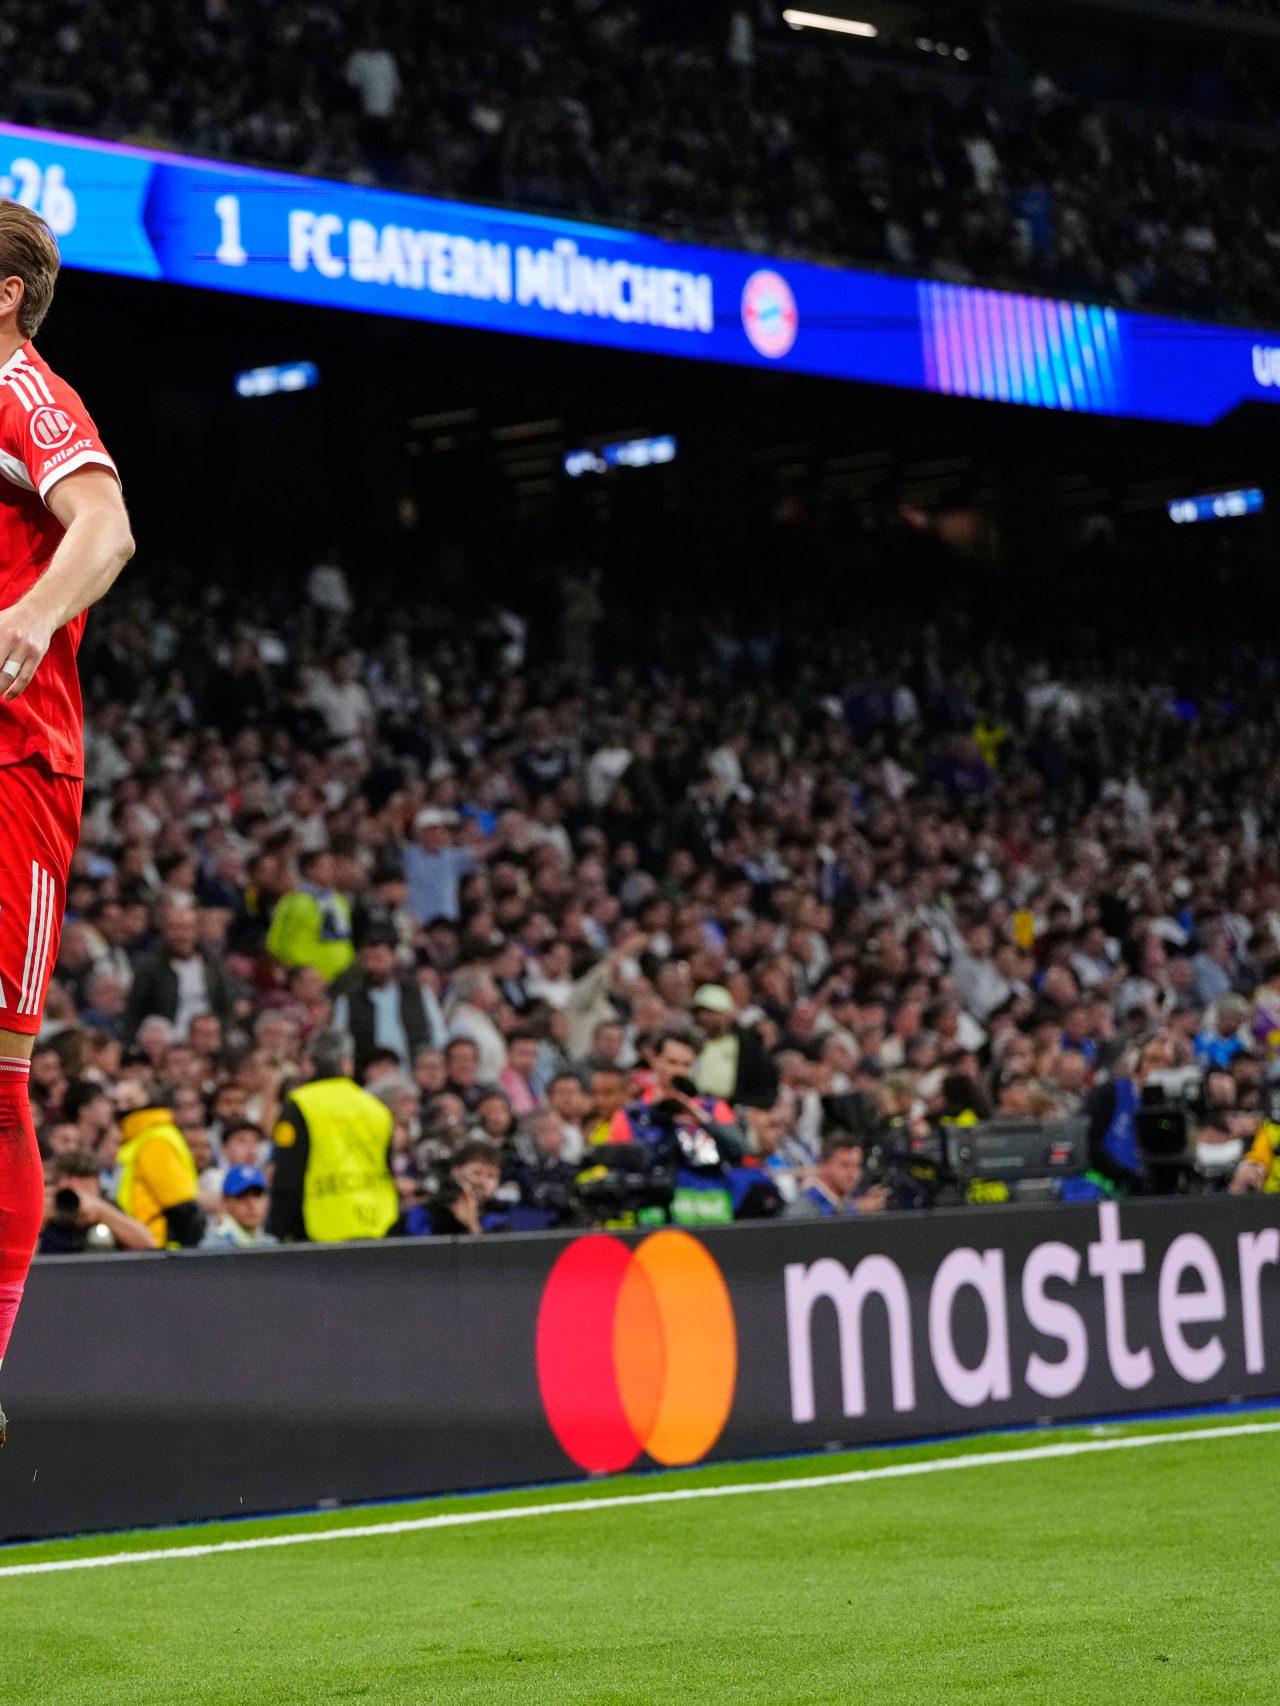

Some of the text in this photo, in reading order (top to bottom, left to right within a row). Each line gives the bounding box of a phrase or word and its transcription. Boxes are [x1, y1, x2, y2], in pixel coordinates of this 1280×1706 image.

[215, 196, 248, 267] 1
[288, 209, 345, 279] FC
[348, 218, 512, 304] BAYERN
[515, 238, 714, 334] MÜNCHEN
[42, 439, 94, 472] Allianz
[784, 1202, 1280, 1423] master
